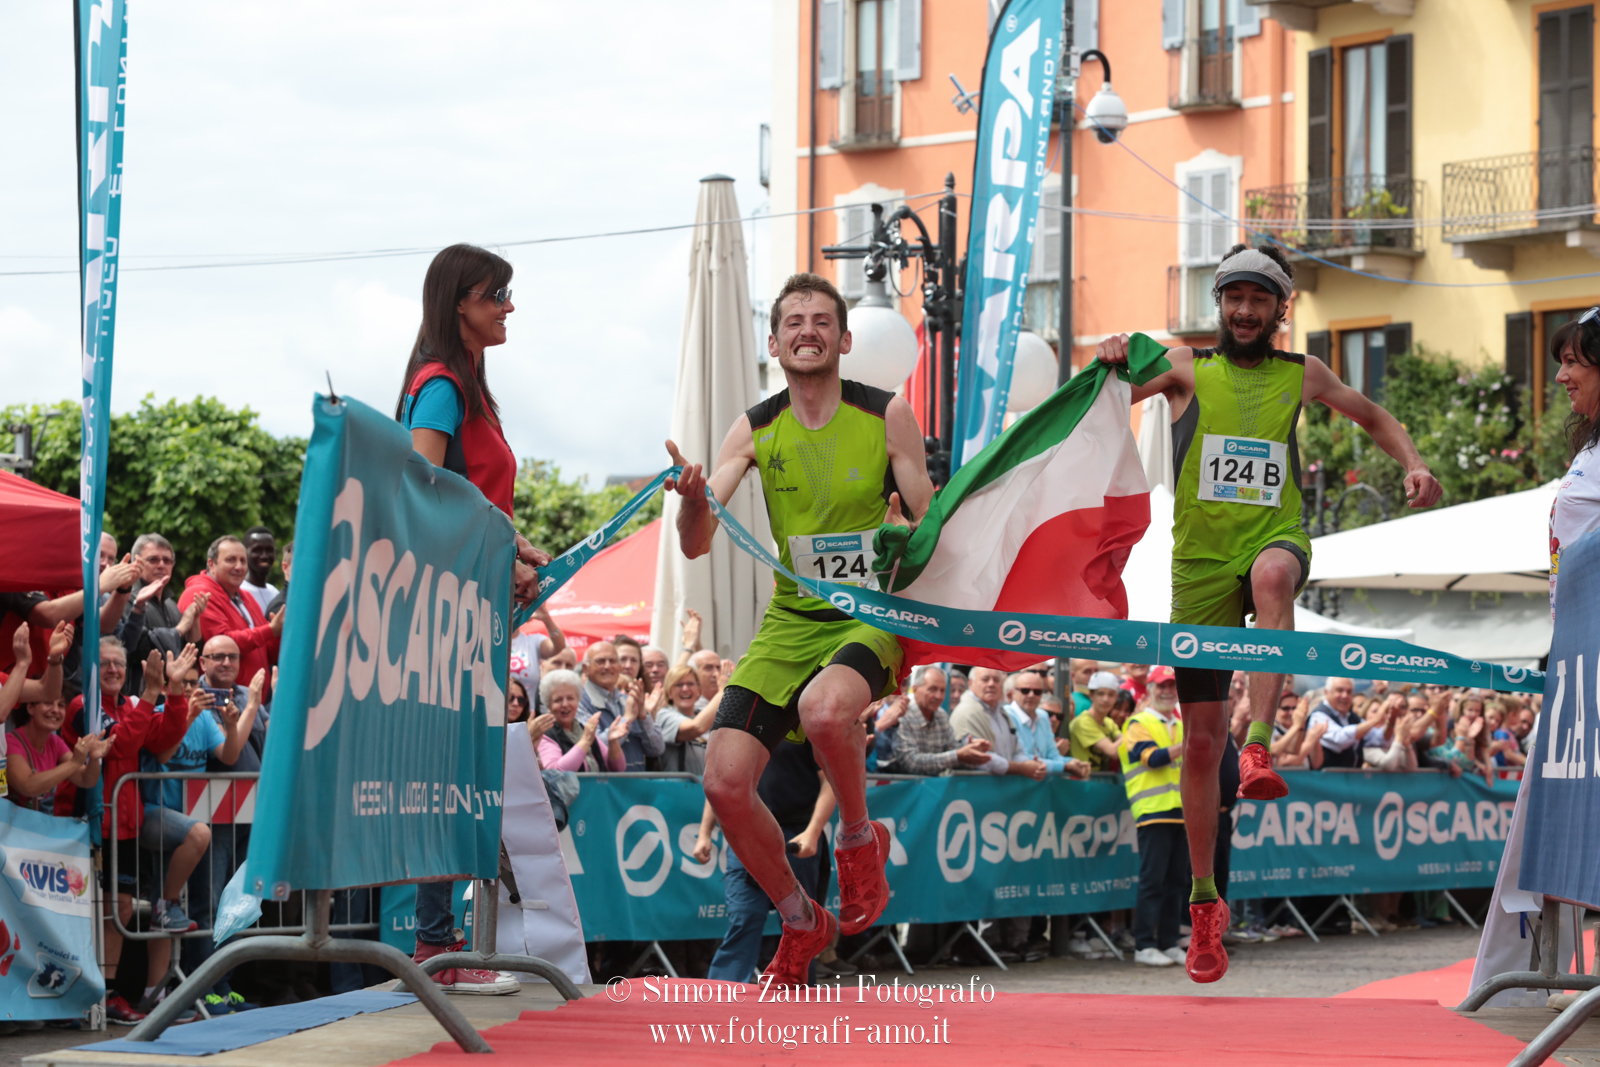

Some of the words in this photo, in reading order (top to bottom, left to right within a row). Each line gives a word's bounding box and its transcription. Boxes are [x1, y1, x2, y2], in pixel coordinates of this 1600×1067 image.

[1238, 445, 1268, 453] SCARPA
[1209, 457, 1254, 484] 124
[1263, 462, 1280, 487] B
[813, 554, 868, 579] 124
[1542, 654, 1586, 779] LA
[20, 862, 70, 894] AVIS
